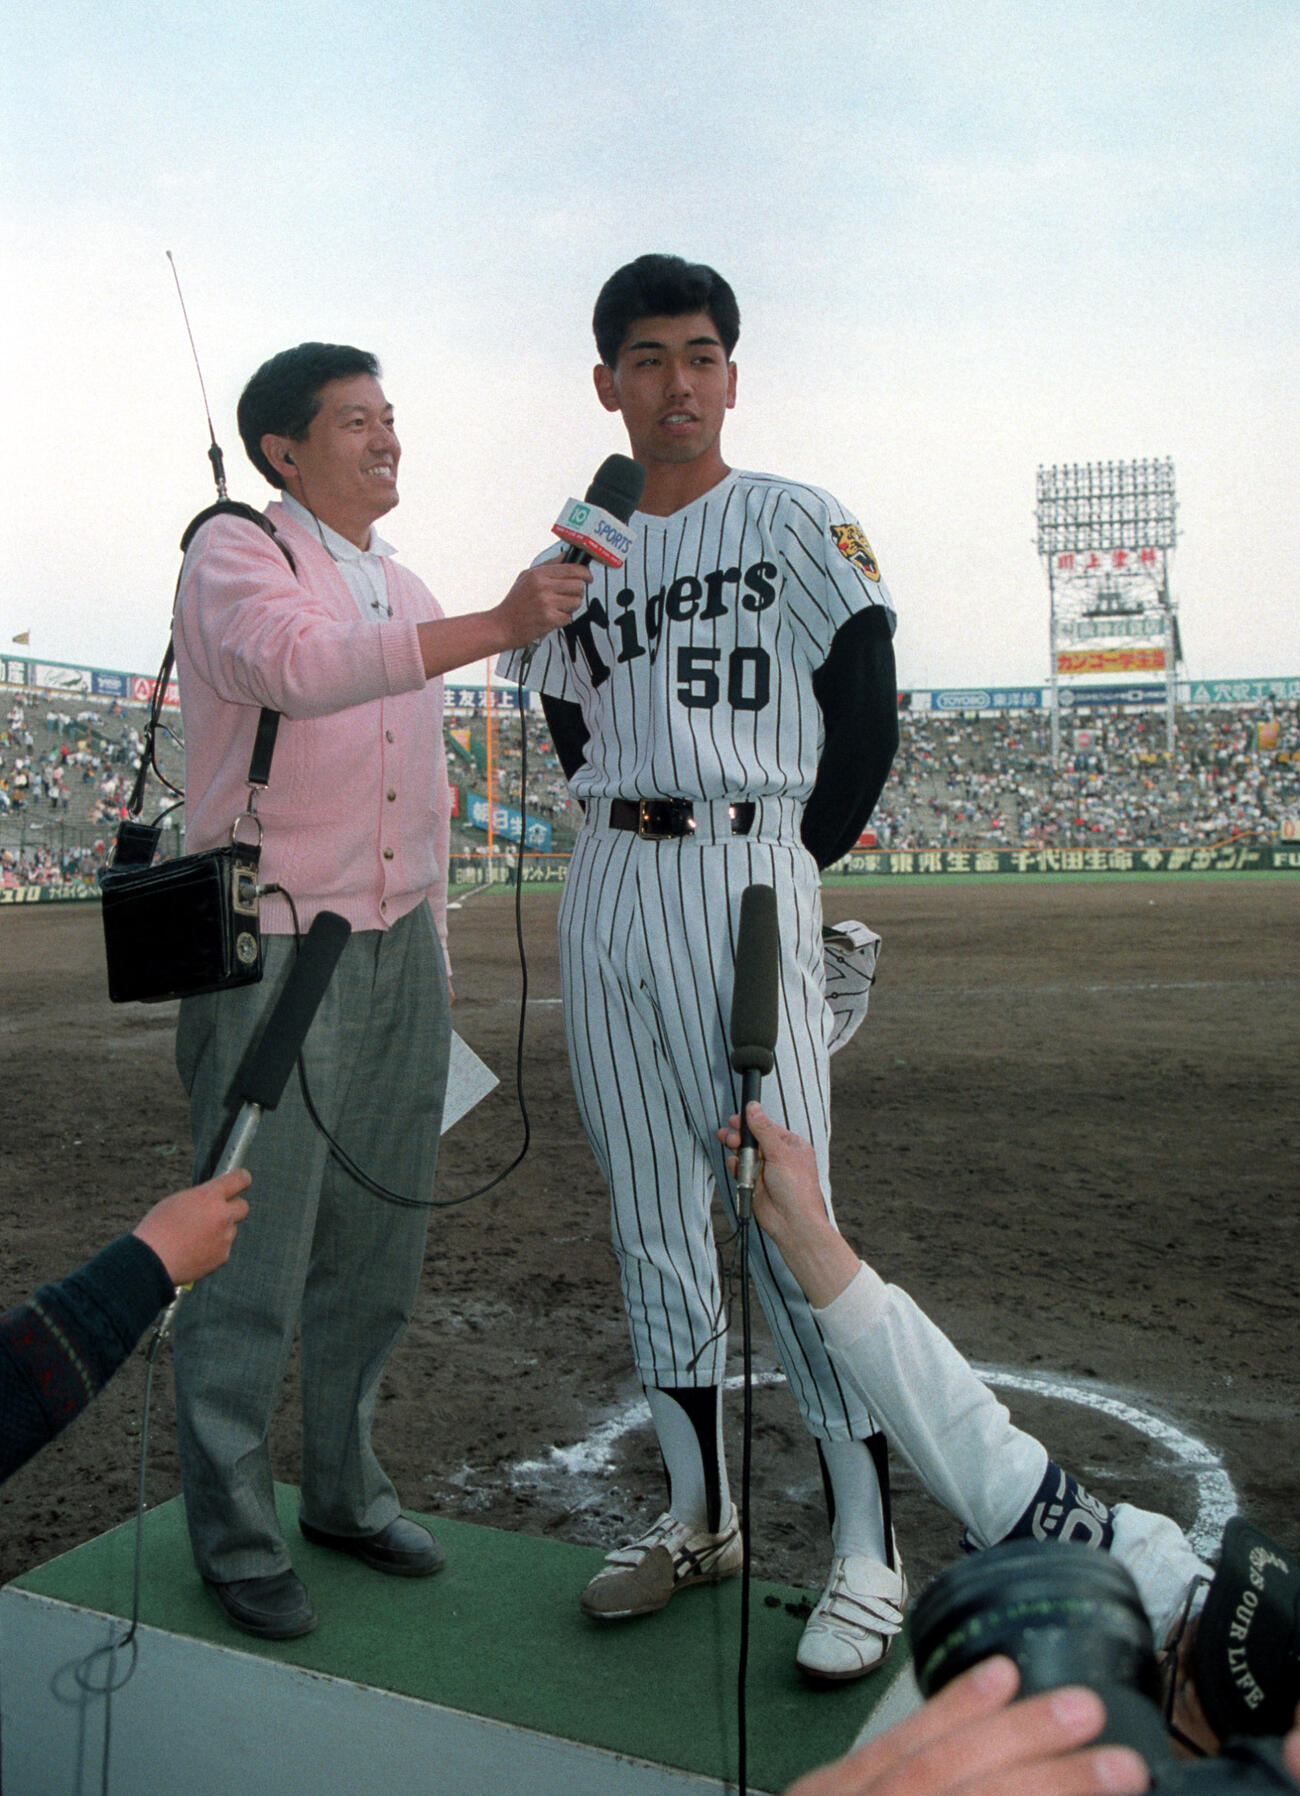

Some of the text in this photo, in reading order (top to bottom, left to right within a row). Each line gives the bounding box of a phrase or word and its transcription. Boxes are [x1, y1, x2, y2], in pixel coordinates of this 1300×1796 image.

[594, 520, 632, 554] SPORTS
[1058, 548, 1156, 570] 川上塗料
[563, 561, 777, 688] Tigers
[677, 646, 771, 712] 50
[1230, 1590, 1259, 1640] OUR
[1228, 1647, 1265, 1710] LIFE
